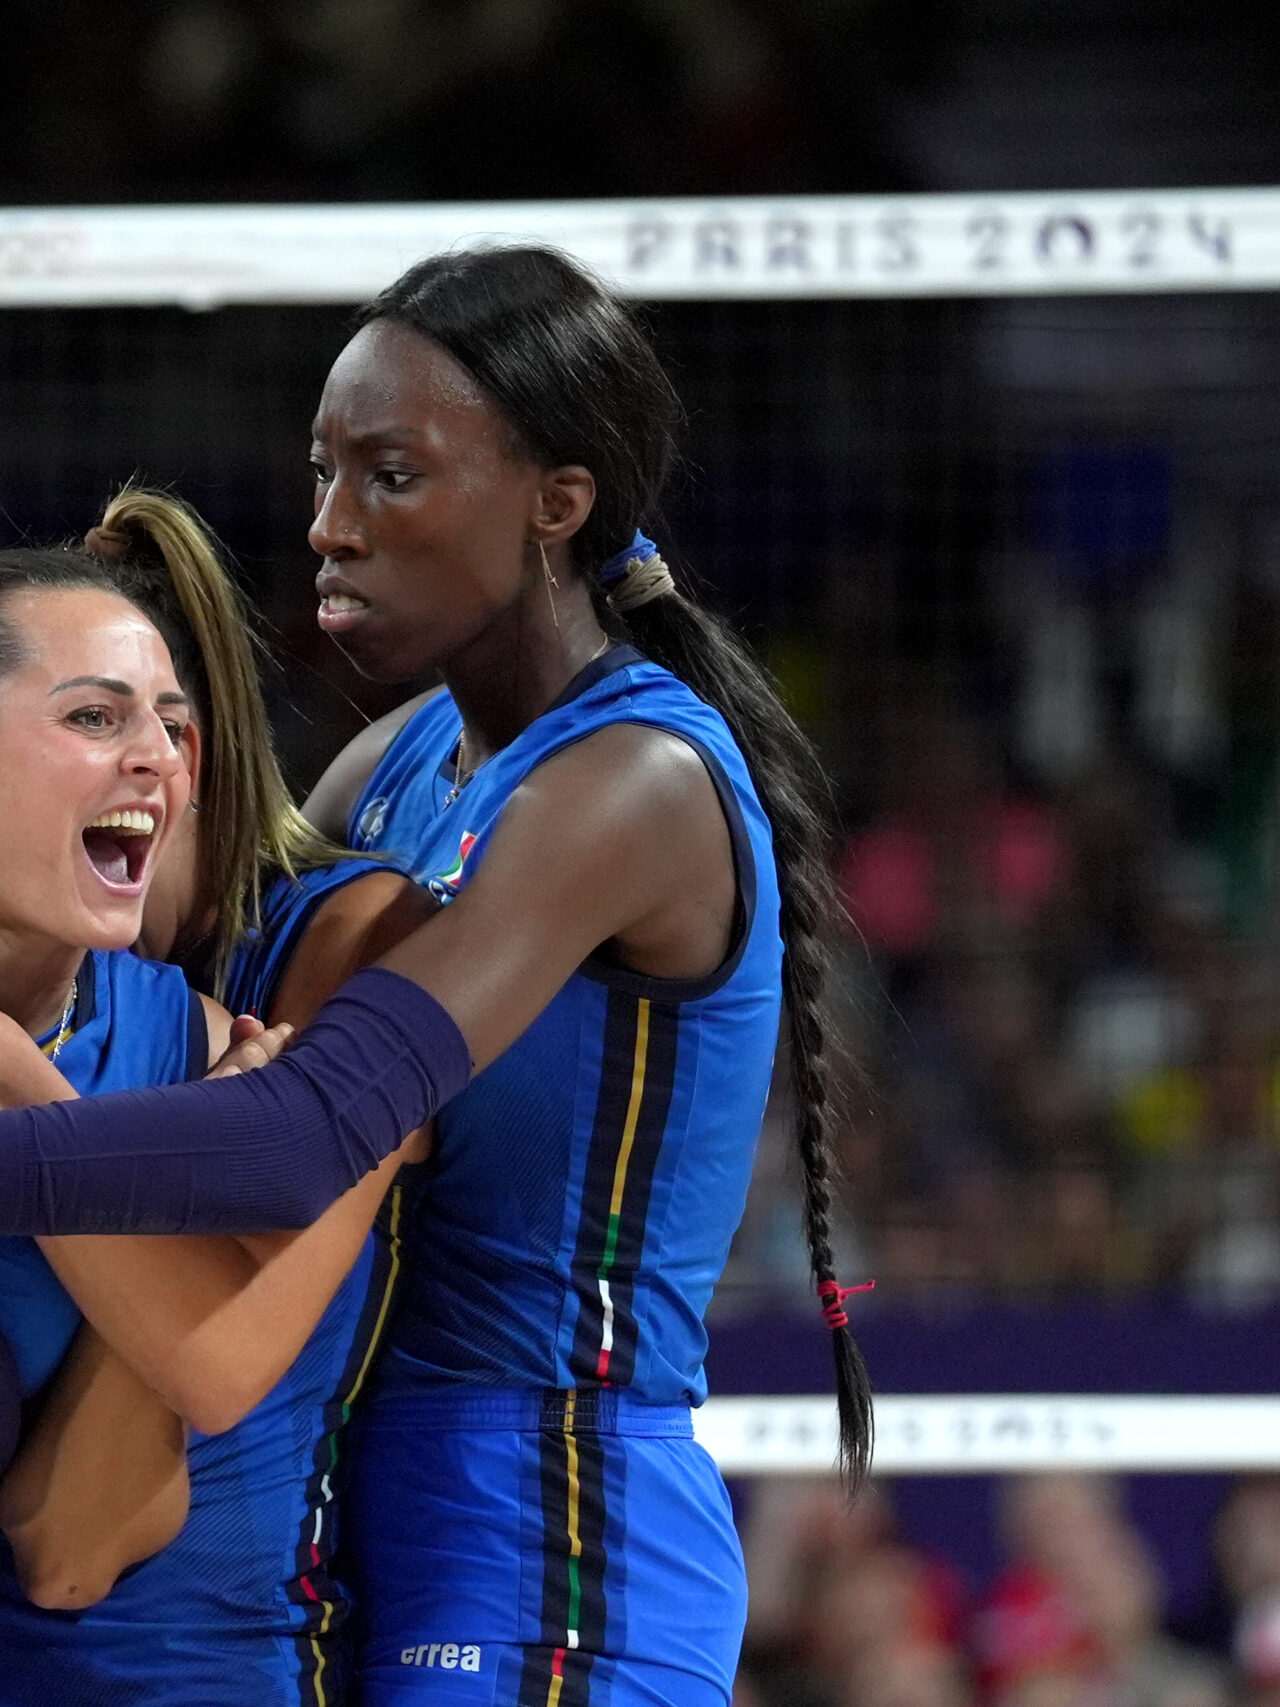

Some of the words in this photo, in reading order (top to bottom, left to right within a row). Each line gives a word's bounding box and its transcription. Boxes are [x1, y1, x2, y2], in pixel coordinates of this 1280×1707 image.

[624, 211, 924, 274] PARIS
[964, 207, 1235, 270] 2024
[400, 1642, 481, 1672] errea
